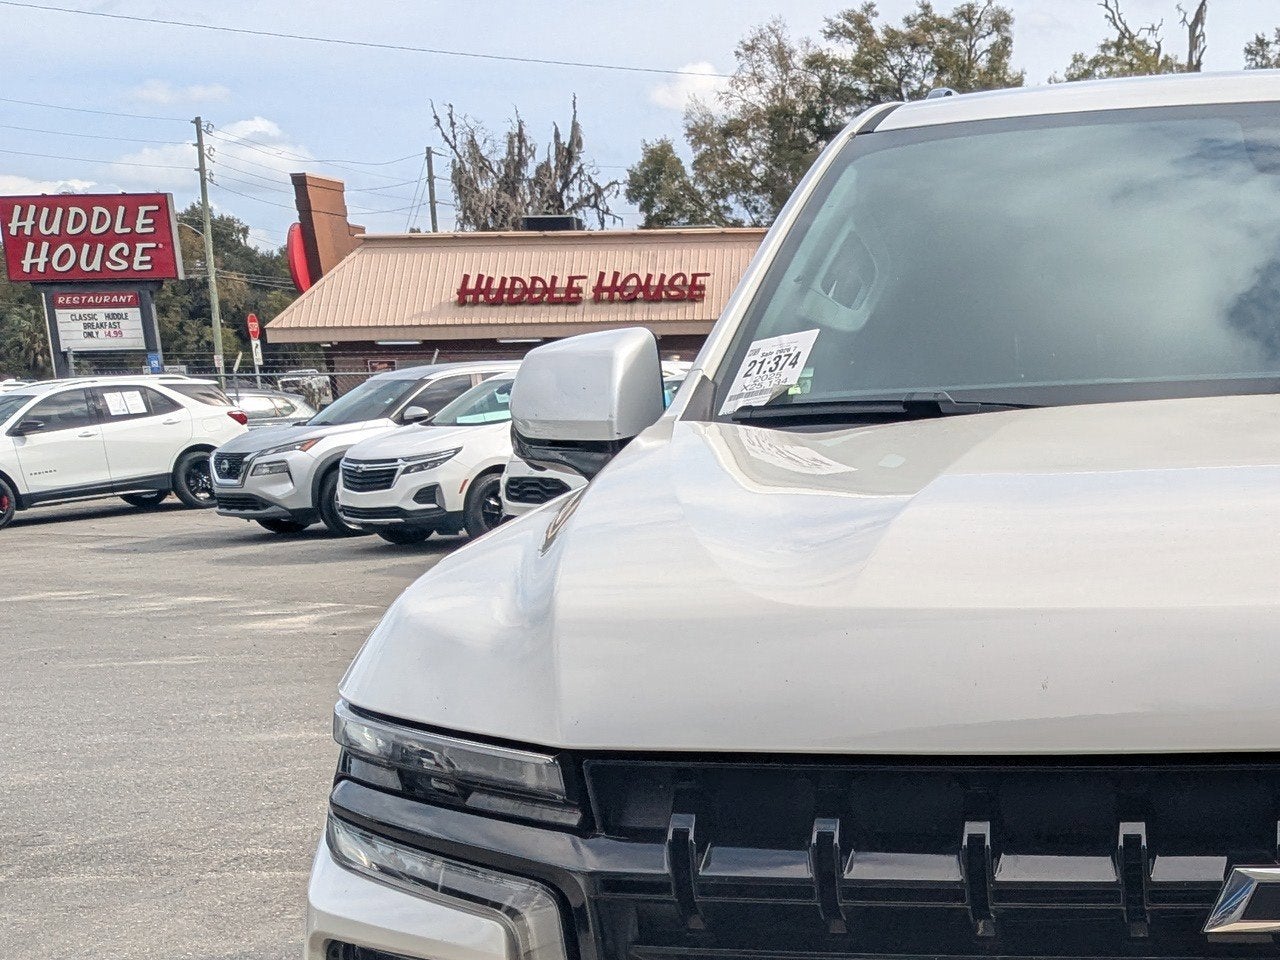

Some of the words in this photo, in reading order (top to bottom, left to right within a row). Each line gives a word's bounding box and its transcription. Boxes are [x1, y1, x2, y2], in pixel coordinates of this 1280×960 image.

[8, 204, 159, 236] HUDDLE
[21, 241, 157, 273] HOUSE
[456, 273, 588, 306] HUDDLE
[592, 270, 711, 303] HOUSE
[58, 295, 134, 305] RESTAURANT
[70, 313, 98, 322] CLASSIC
[104, 312, 129, 321] HUDDLE
[83, 321, 121, 330] BREAKFAST
[83, 330, 100, 339] ONLY
